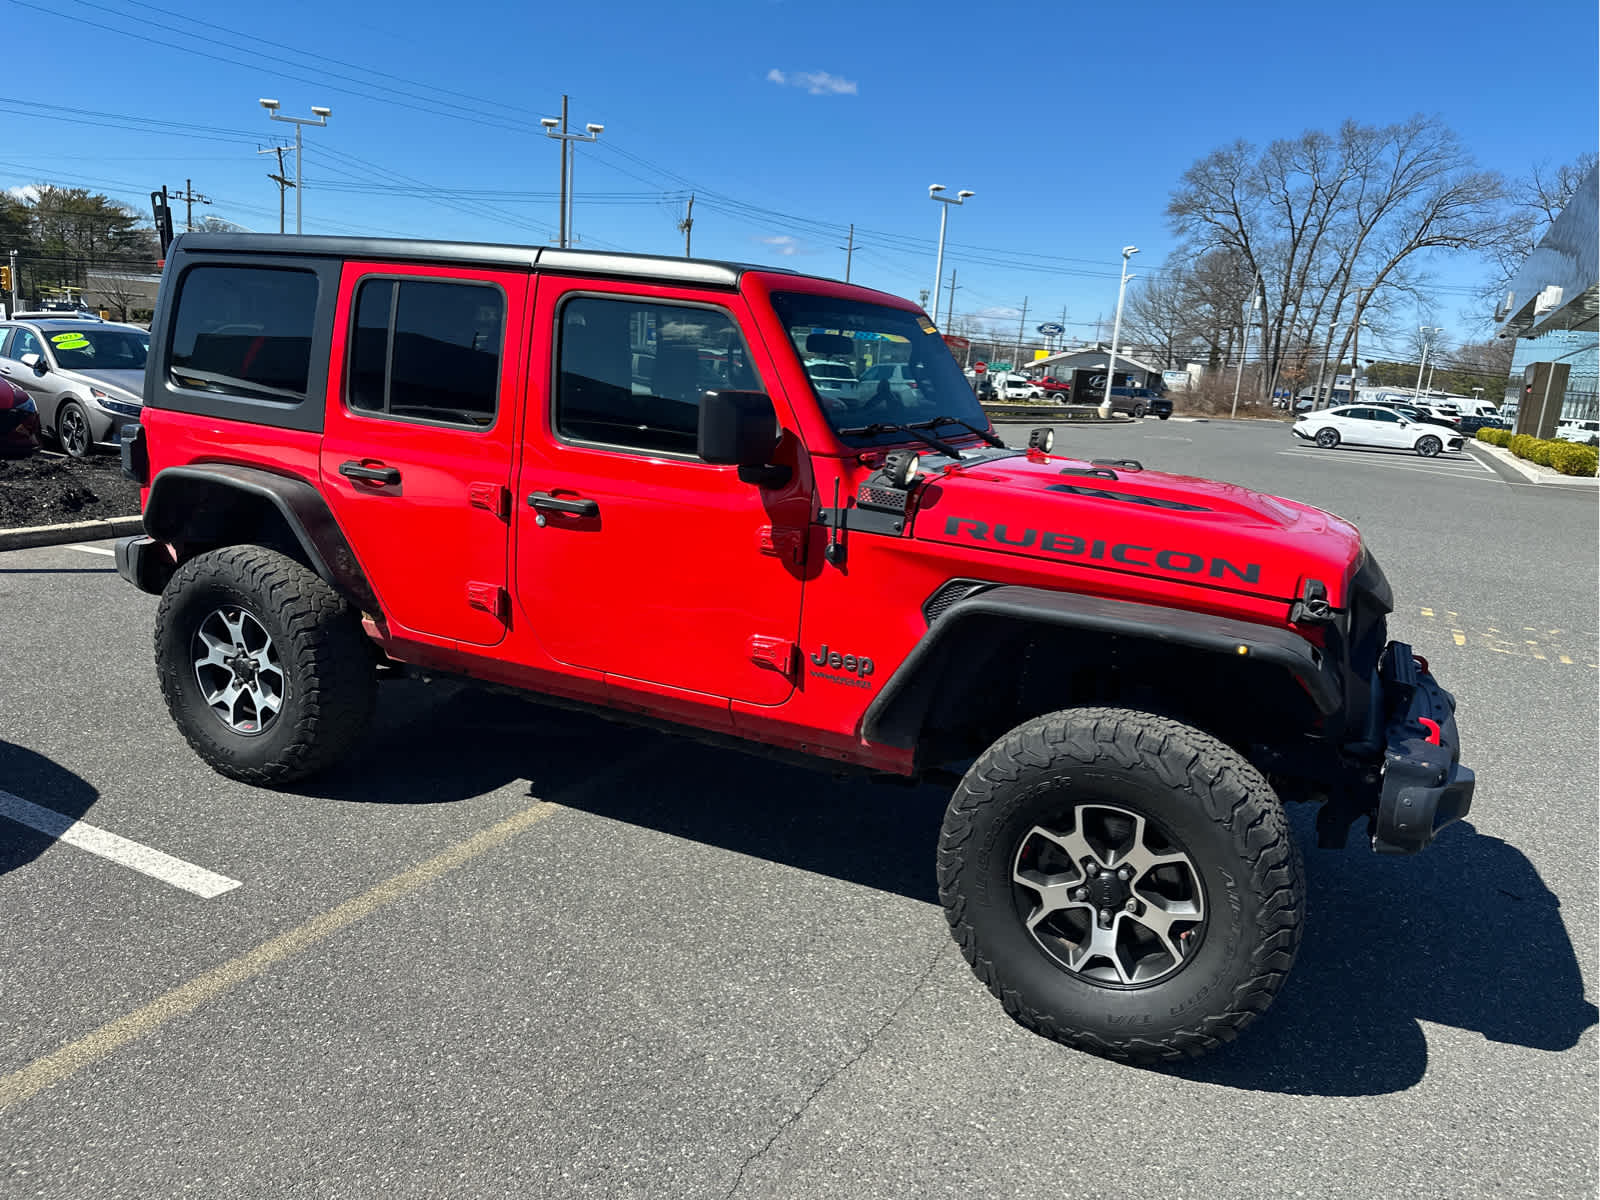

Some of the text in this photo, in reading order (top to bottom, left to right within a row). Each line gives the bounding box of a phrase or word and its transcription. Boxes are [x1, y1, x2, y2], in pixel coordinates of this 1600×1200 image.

[1040, 324, 1061, 335] Ford
[944, 516, 1262, 584] RUBICON
[810, 644, 874, 678] Jeep
